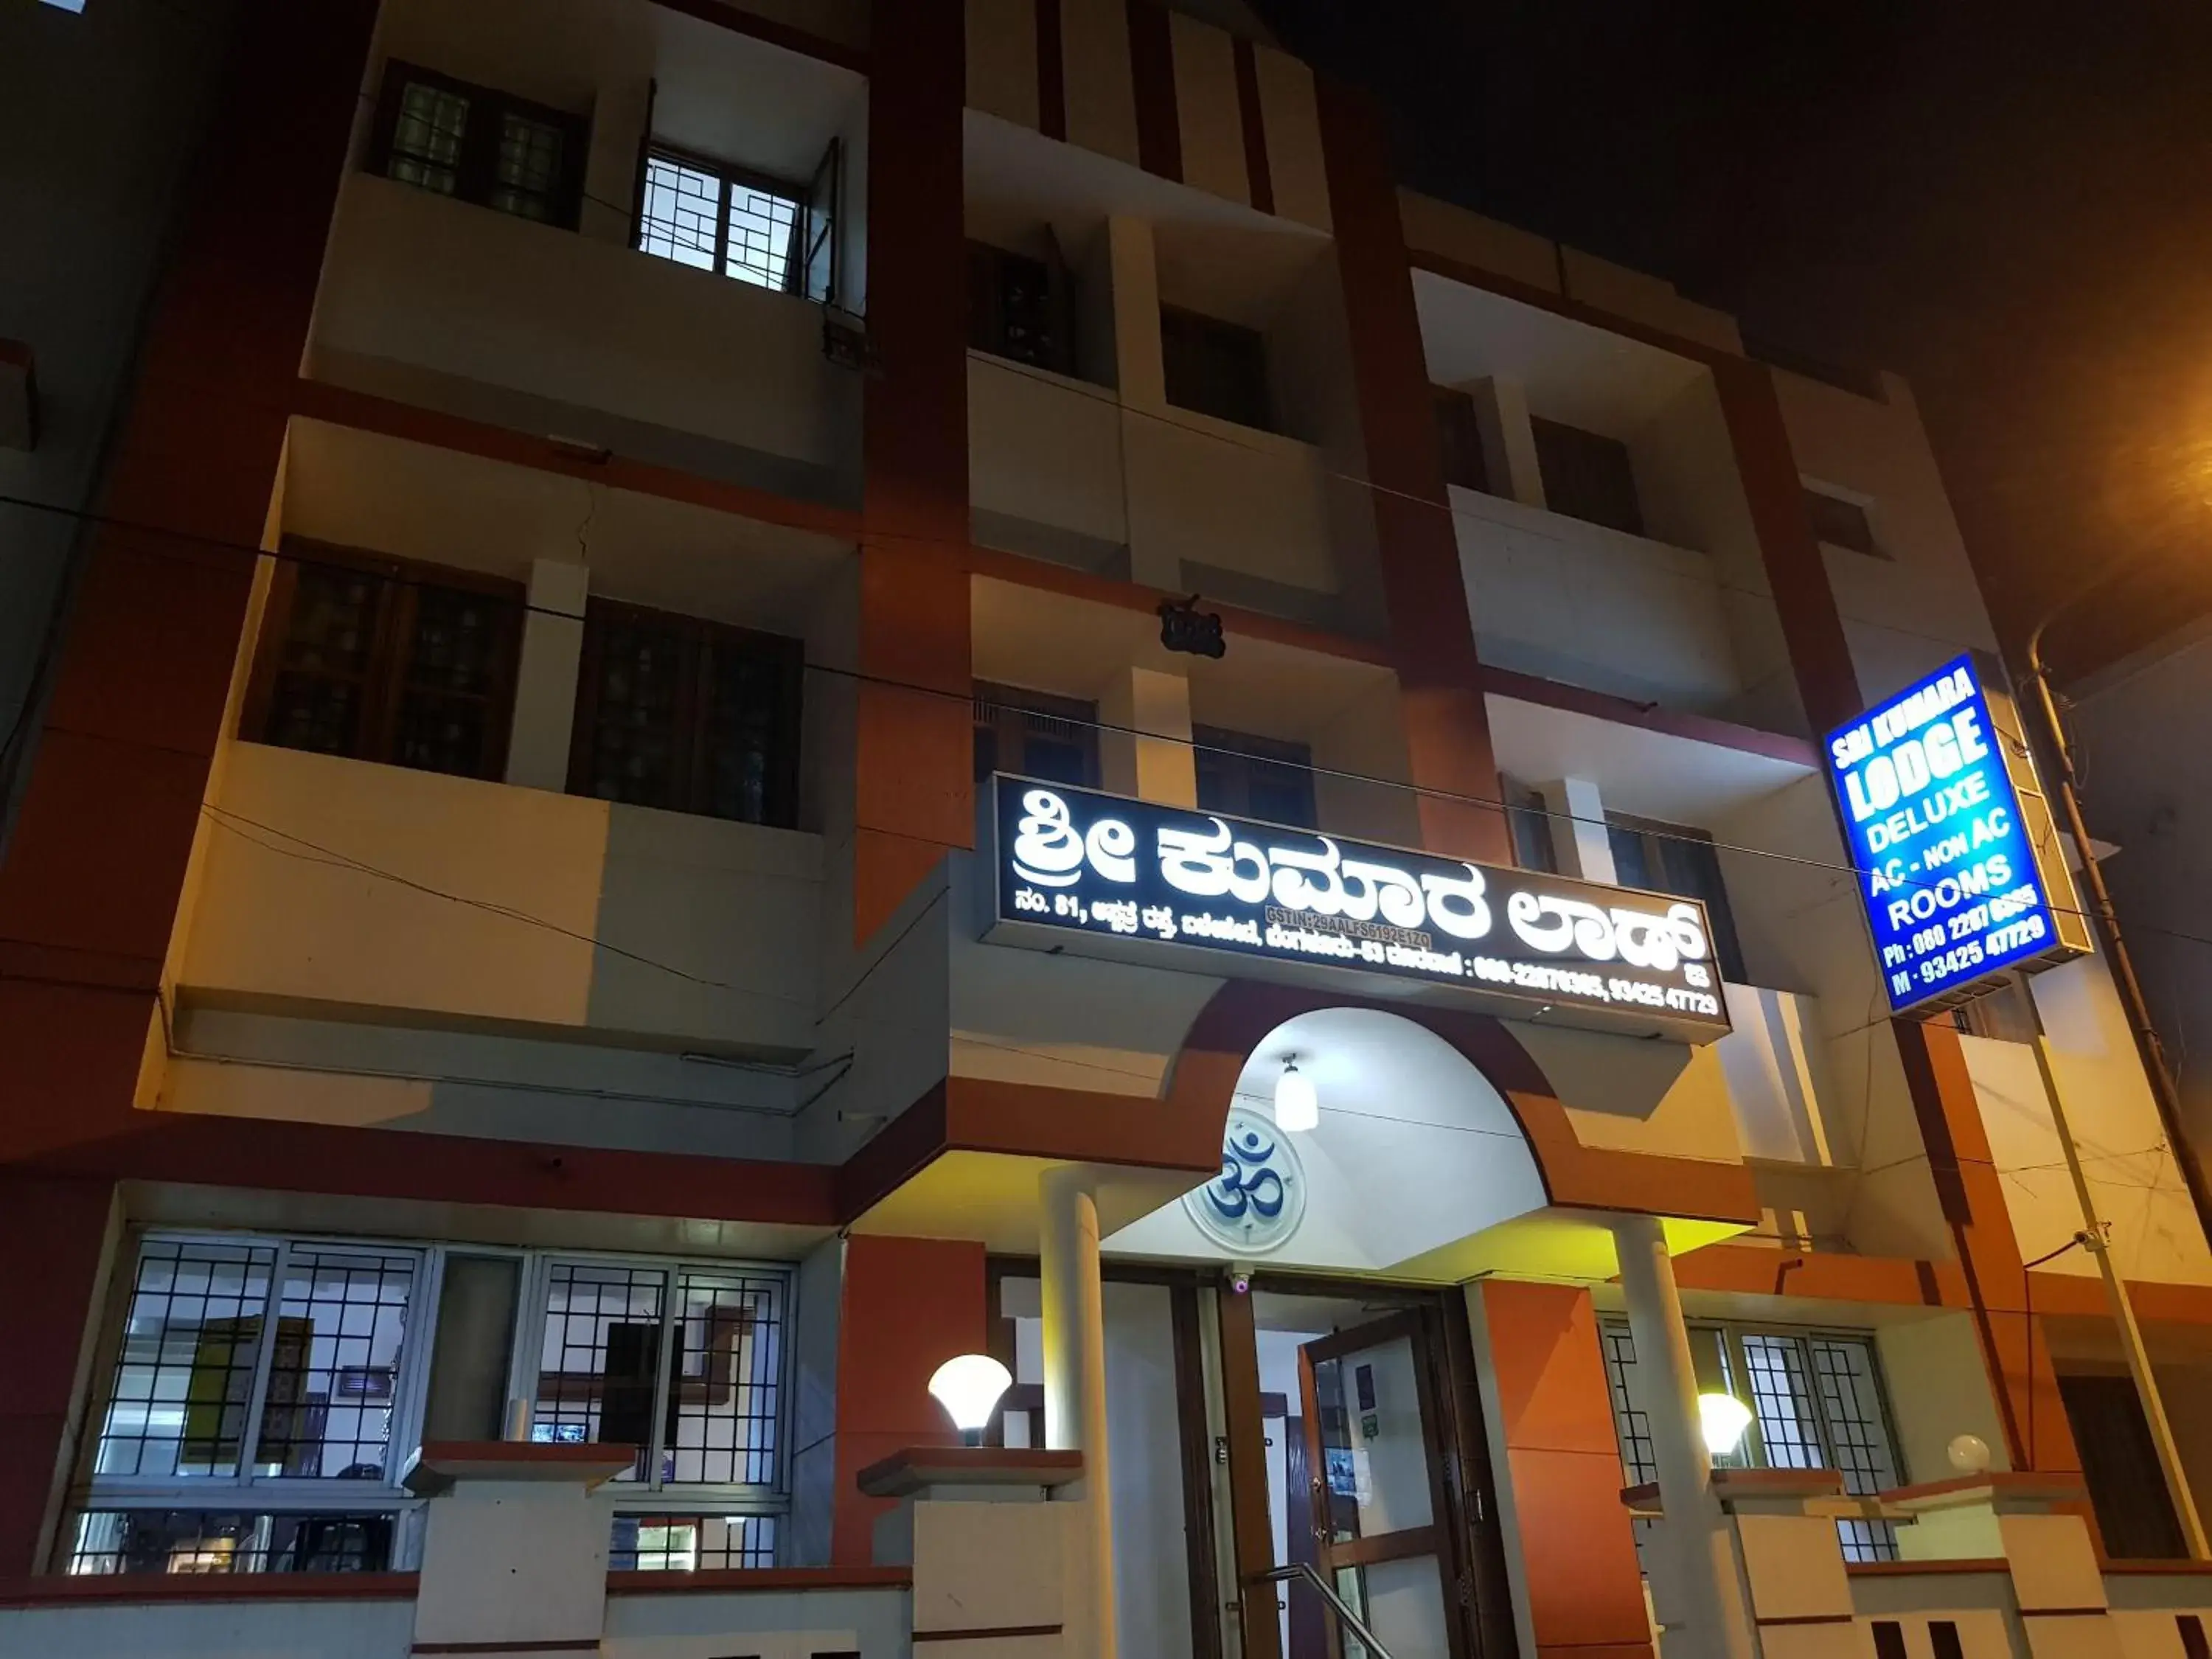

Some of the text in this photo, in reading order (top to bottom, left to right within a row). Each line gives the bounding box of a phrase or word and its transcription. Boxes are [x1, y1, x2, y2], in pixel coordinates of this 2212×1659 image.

[1832, 667, 1975, 769] SRI KUMARA
[1845, 706, 1989, 822] LODGE
[1866, 771, 1990, 854] DELUXE
[1871, 858, 1906, 897] AC
[1923, 832, 1969, 870] NON
[1972, 807, 2011, 849] AC
[1012, 790, 1137, 887] ಶ್ರೀ
[1157, 816, 1492, 939] ಕುಮಾರ
[1887, 854, 2012, 931] ROOMS
[1920, 940, 1984, 984] 93425
[1986, 914, 2046, 956] 47729
